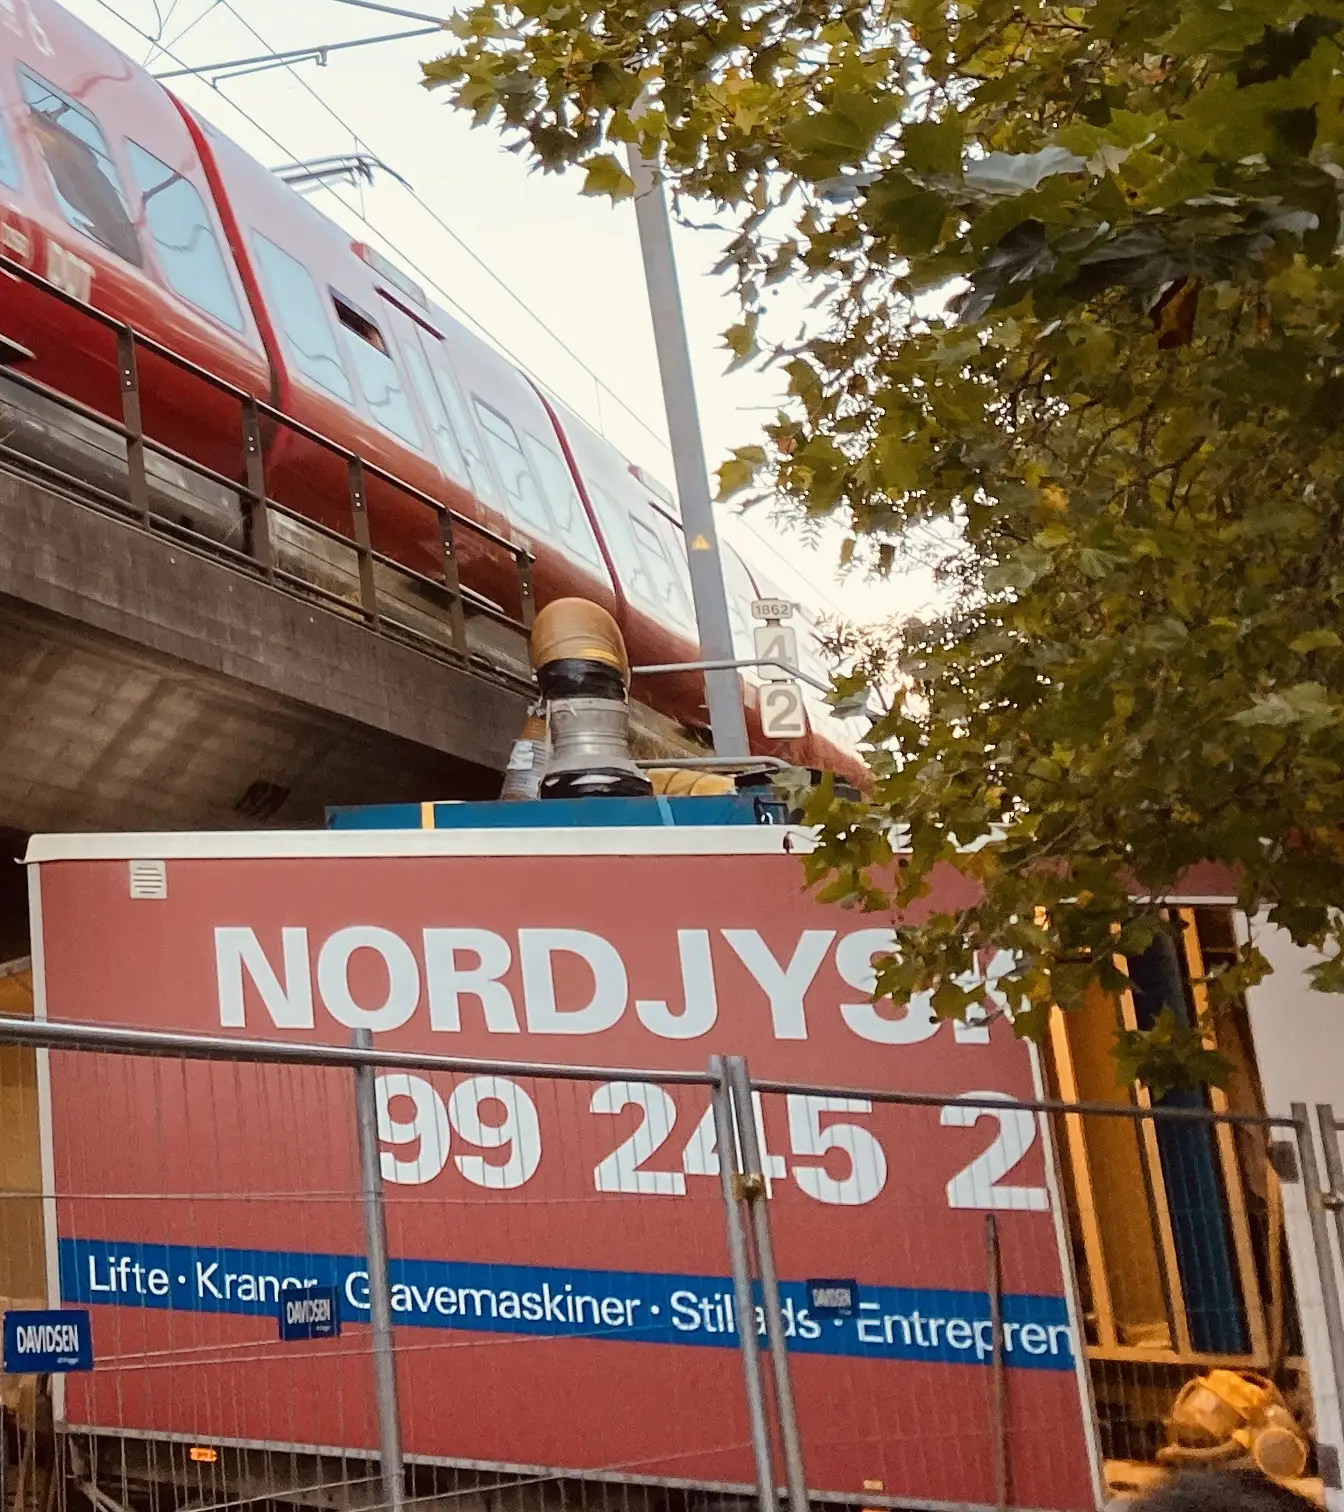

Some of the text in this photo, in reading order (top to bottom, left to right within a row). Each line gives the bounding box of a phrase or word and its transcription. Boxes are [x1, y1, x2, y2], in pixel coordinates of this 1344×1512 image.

[761, 634, 792, 664] 4
[766, 689, 802, 732] 2
[374, 1073, 542, 1190] 99
[939, 1090, 1050, 1211] 2
[88, 1255, 169, 1295] Lifte
[344, 1271, 641, 1327] Gavemaskiner
[16, 1324, 80, 1354] DAVIDSEN
